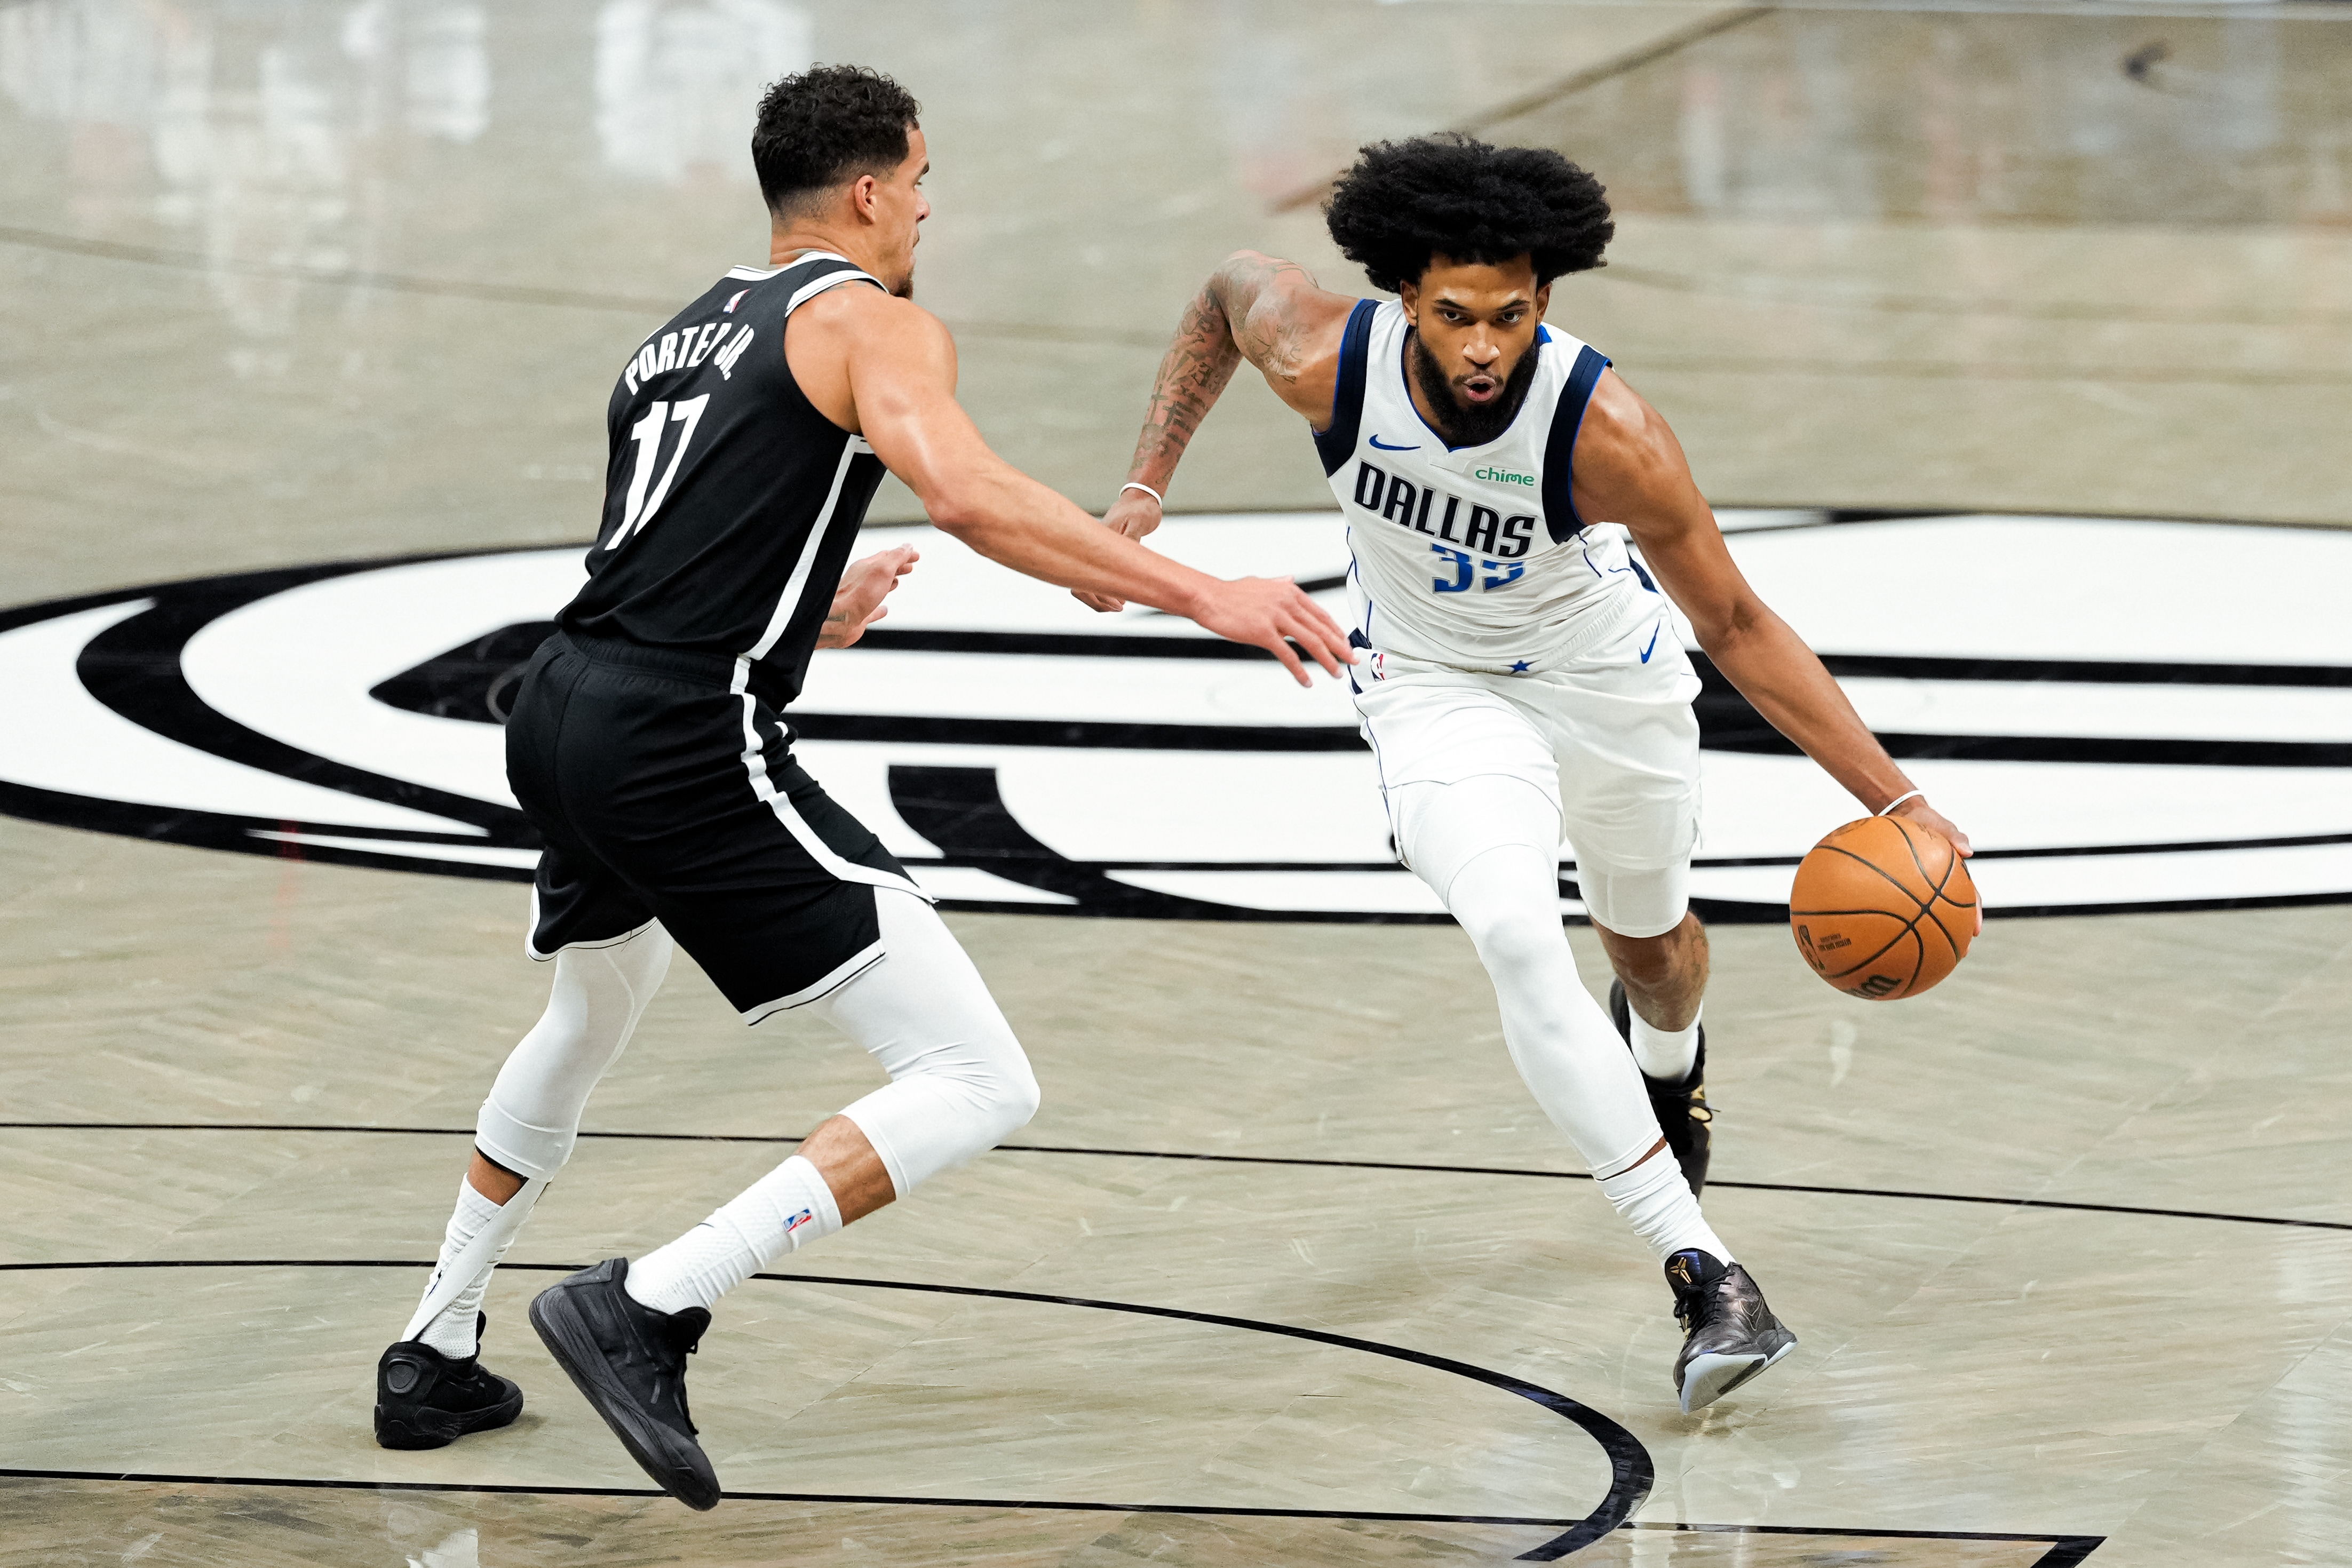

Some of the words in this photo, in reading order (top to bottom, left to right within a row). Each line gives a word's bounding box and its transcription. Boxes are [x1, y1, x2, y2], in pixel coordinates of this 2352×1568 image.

[714, 323, 754, 381] JR.
[604, 393, 710, 551] 17
[1353, 458, 1538, 559] DALLAS
[1475, 462, 1535, 486] chime
